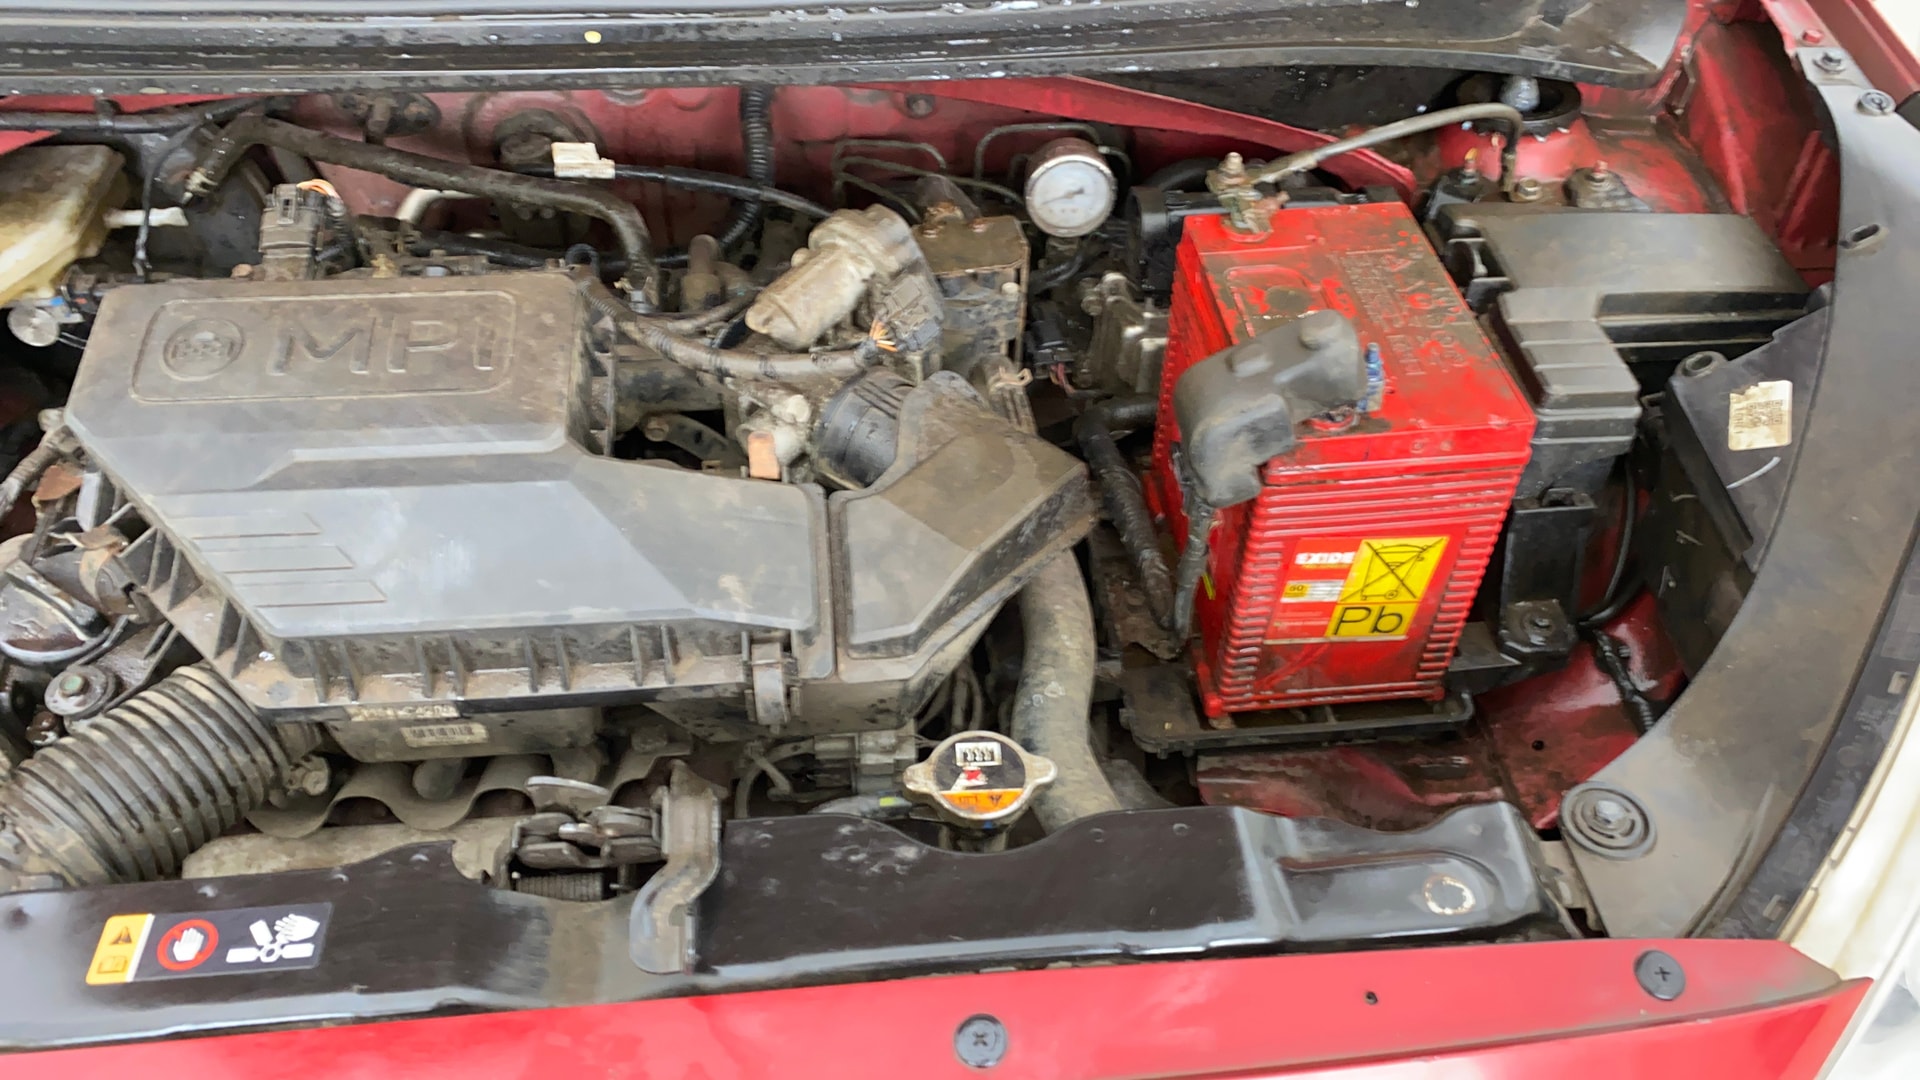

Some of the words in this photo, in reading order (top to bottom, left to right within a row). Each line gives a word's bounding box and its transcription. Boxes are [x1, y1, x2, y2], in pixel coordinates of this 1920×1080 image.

[266, 315, 496, 376] MPI
[1294, 551, 1356, 564] EXIDE
[1332, 605, 1403, 636] Pb
